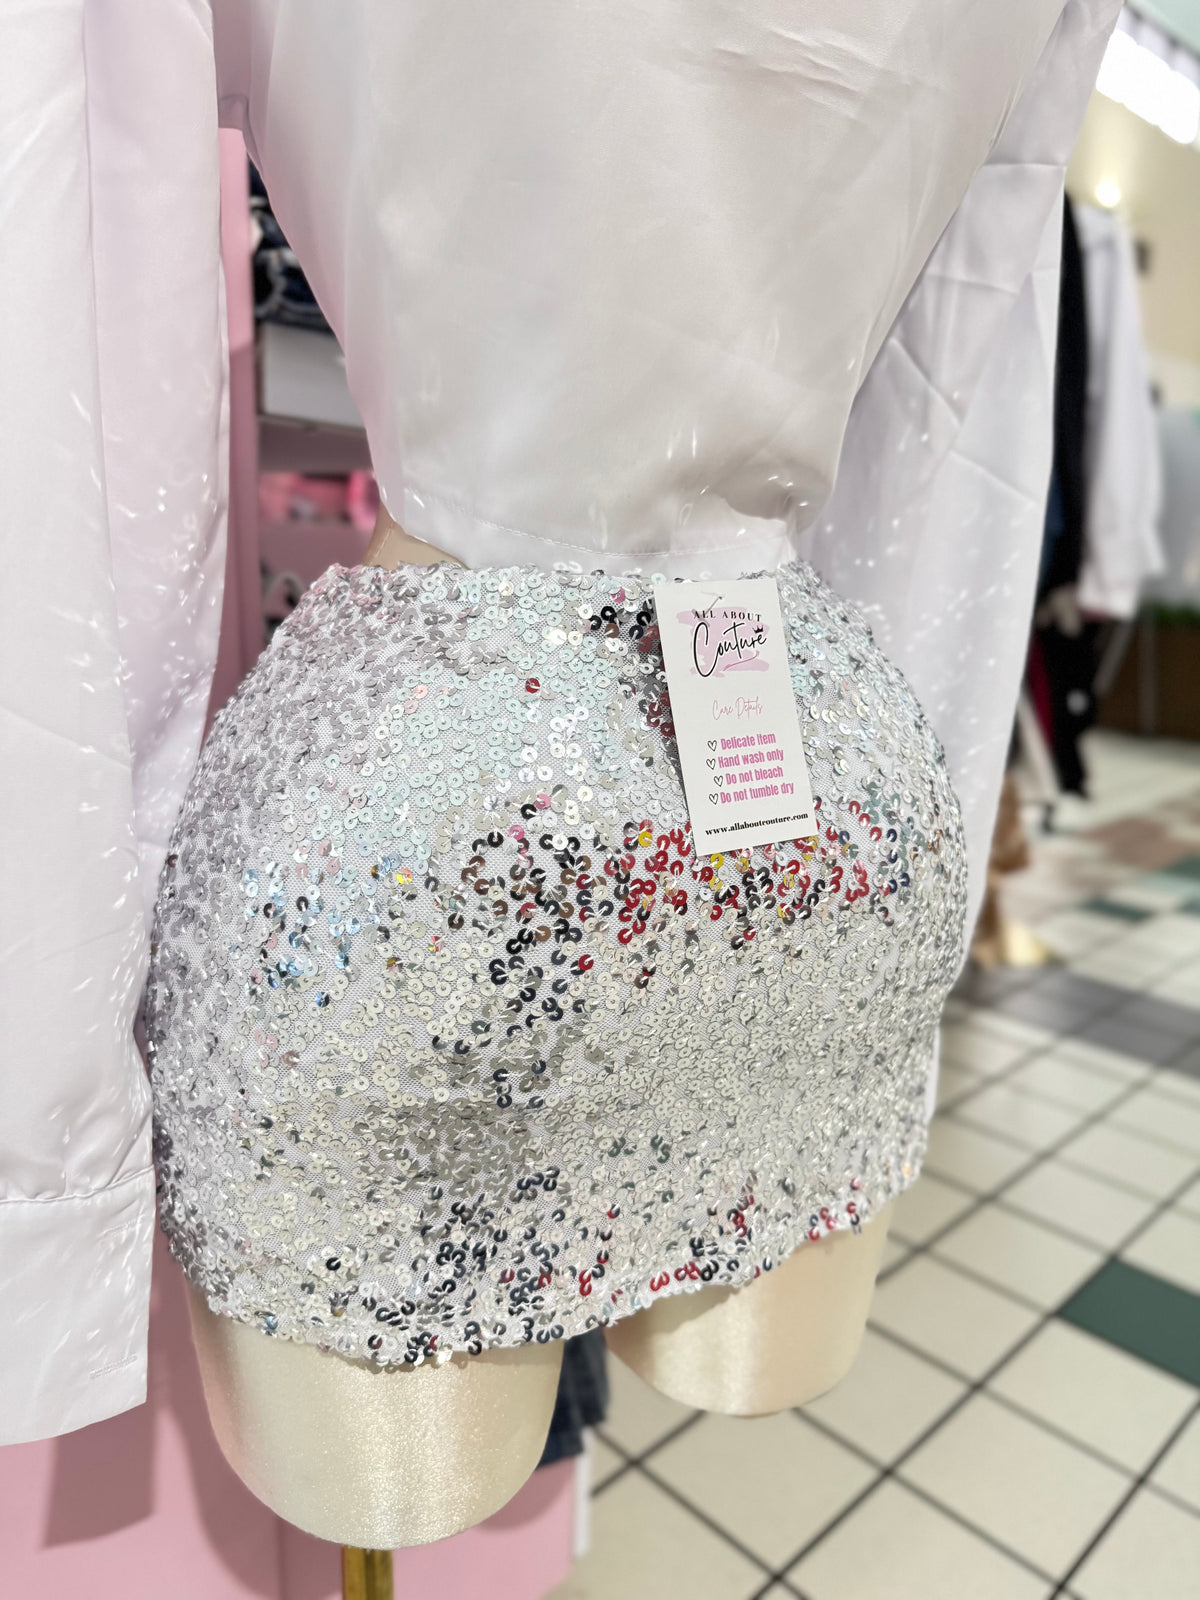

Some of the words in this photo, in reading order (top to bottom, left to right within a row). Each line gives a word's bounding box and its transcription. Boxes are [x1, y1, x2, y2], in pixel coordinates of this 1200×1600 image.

[694, 610, 716, 620] ALL
[722, 611, 762, 622] ABOUT
[694, 622, 767, 678] Couture
[712, 700, 733, 720] Care
[736, 696, 763, 719] Details
[720, 736, 756, 750] Delicate
[718, 754, 740, 768] Hand
[742, 750, 765, 764] wash
[766, 748, 784, 762] only
[726, 773, 737, 785] Do
[738, 770, 754, 783] not
[754, 766, 784, 780] bleach
[720, 791, 732, 804] Do
[733, 788, 748, 802] not
[749, 784, 780, 800] tumble
[780, 782, 794, 795] dry
[705, 812, 808, 836] www.allaboutcouture.com
